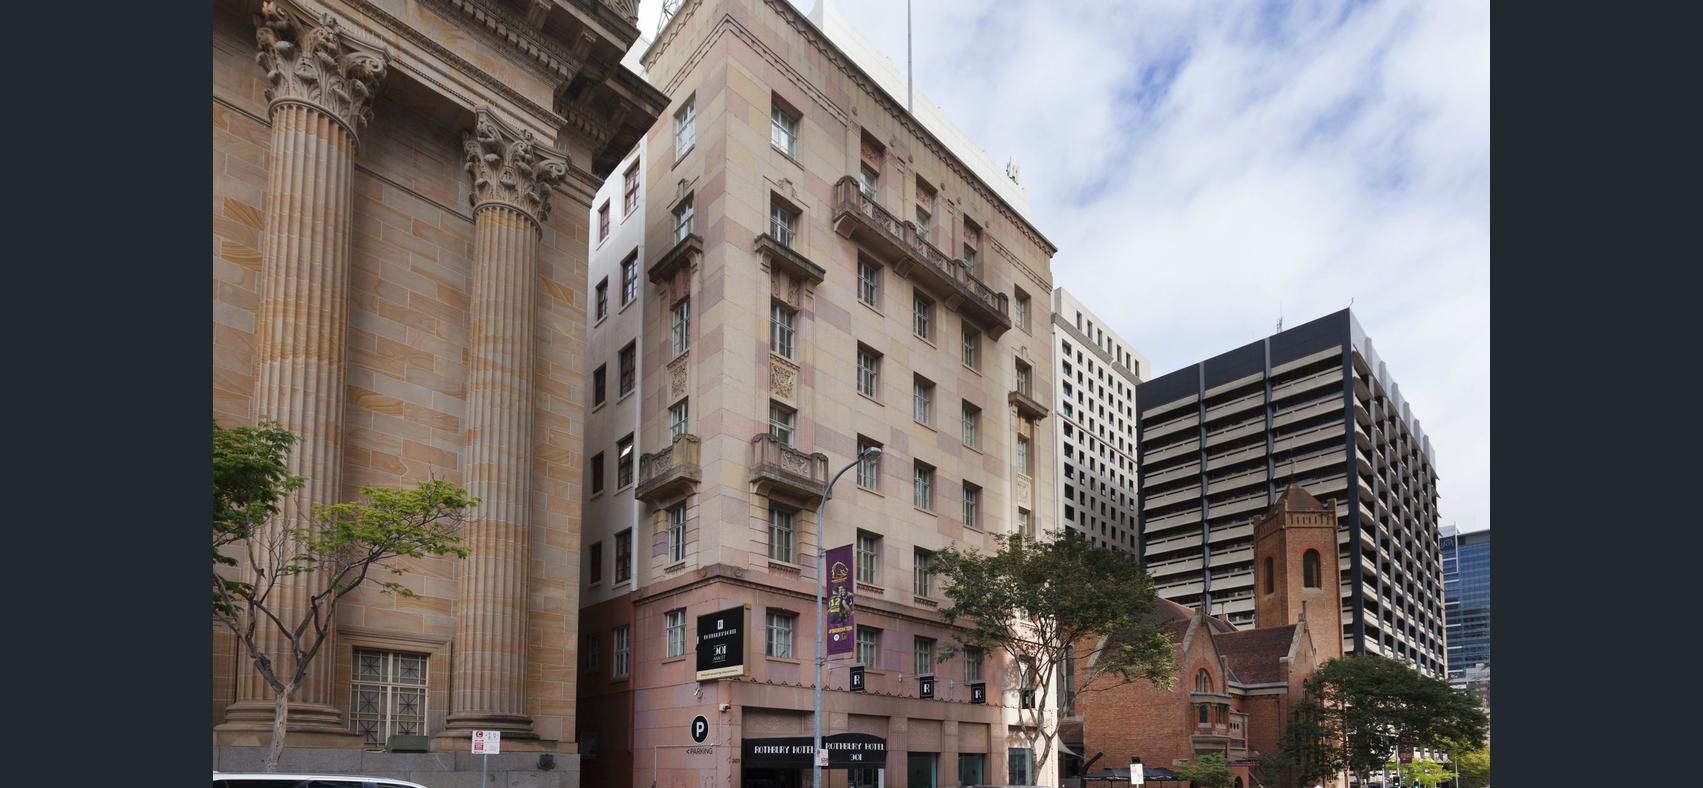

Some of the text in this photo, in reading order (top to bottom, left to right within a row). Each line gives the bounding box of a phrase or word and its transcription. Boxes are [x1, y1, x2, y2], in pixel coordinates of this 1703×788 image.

[853, 674, 861, 686] R
[923, 683, 930, 694] R
[975, 689, 982, 700] R
[696, 721, 705, 738] P
[754, 745, 814, 754] ROTHBURY HOTEL
[825, 742, 884, 751] ROTHBURY HOTEL
